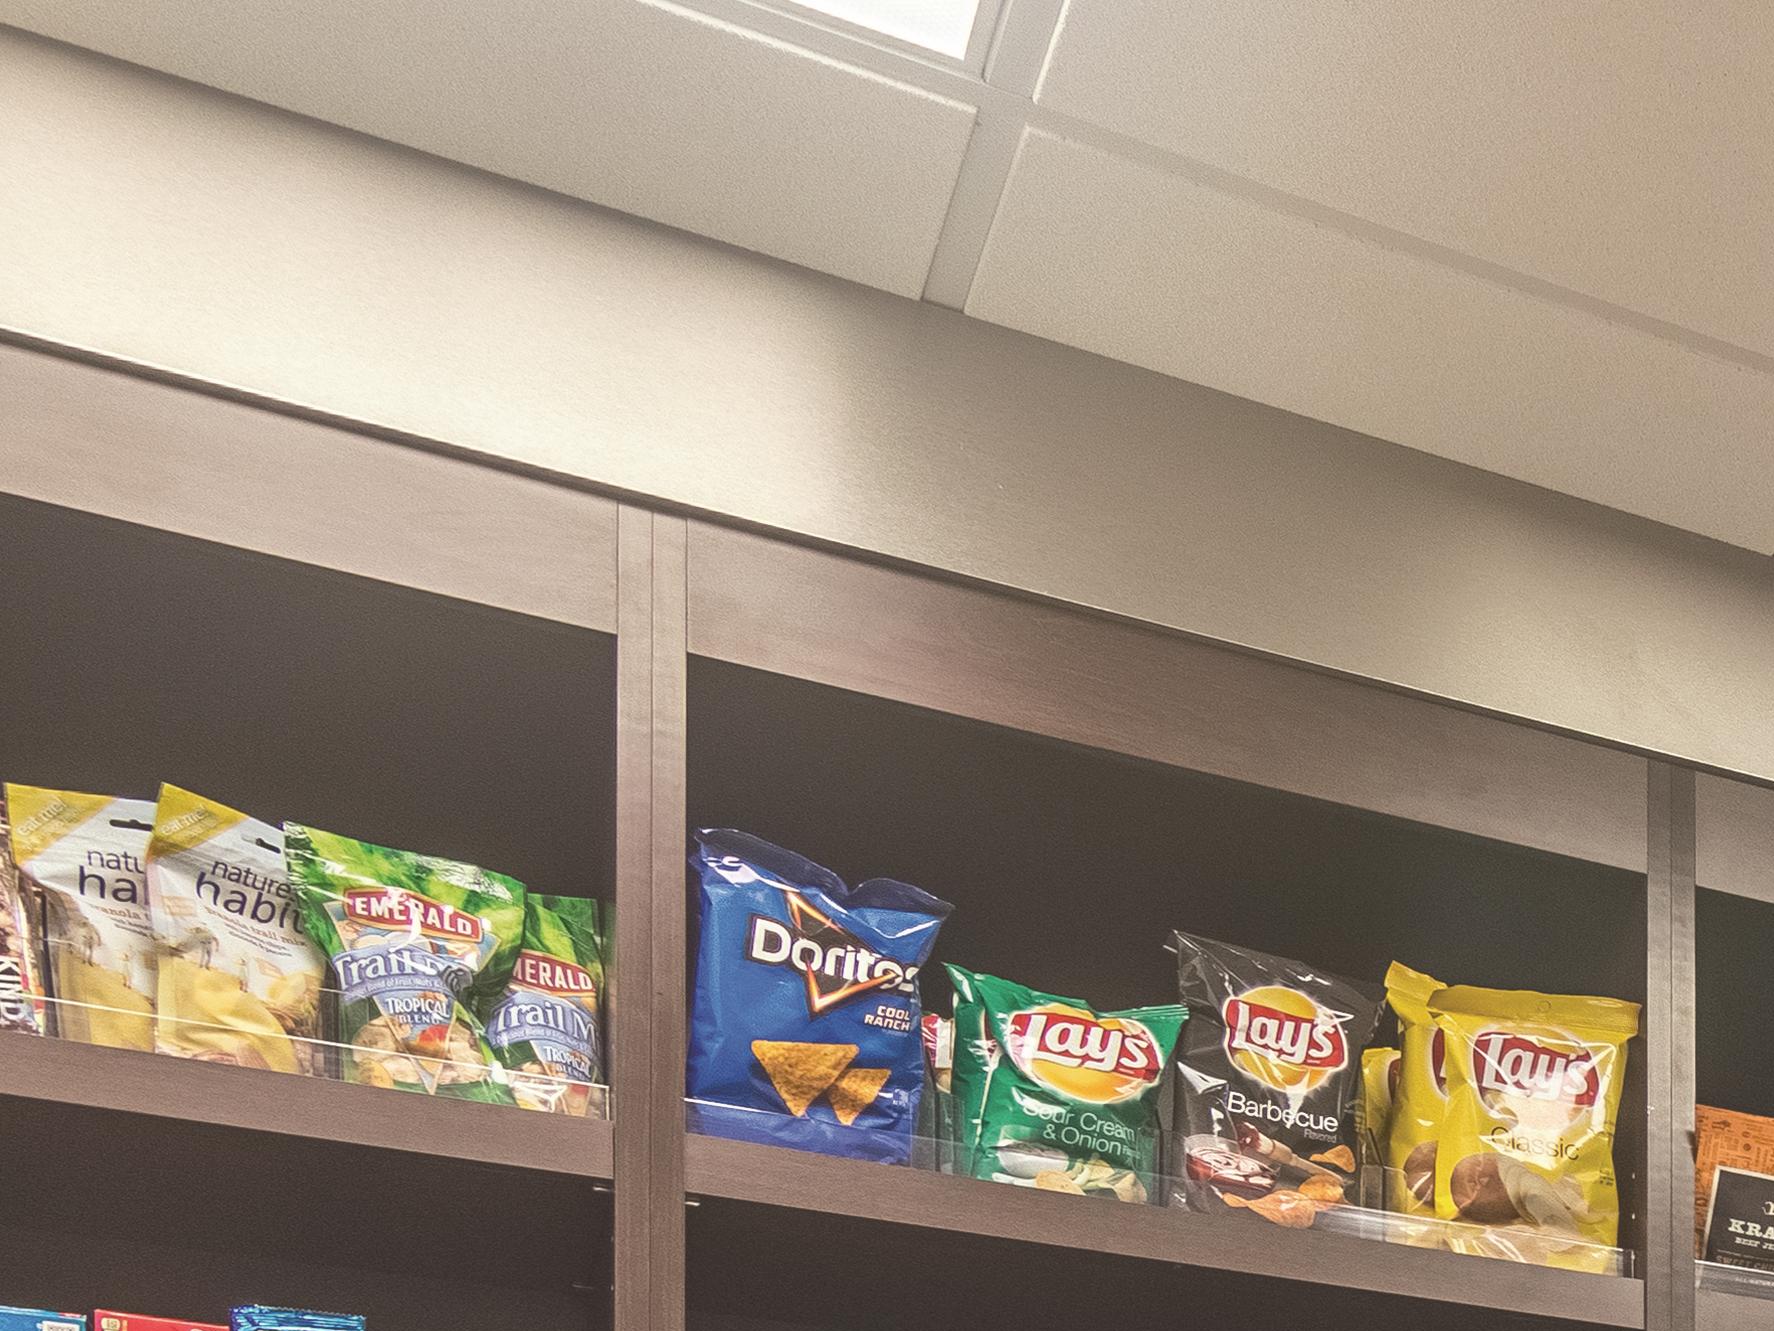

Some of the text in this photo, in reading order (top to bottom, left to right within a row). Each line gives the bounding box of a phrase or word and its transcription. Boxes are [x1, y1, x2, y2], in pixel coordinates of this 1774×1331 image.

[352, 892, 475, 938] EMERALD
[384, 998, 448, 1016] TROPICAL
[864, 1013, 910, 1031] RANCH
[877, 1005, 910, 1021] COOL
[1234, 1002, 1334, 1064] Lay's
[1482, 1035, 1591, 1101] Lay's
[1079, 1109, 1135, 1140] Cream
[1228, 1091, 1338, 1131] Barbecue
[1043, 1124, 1122, 1156] & Onion
[1492, 1126, 1580, 1161] Classic
